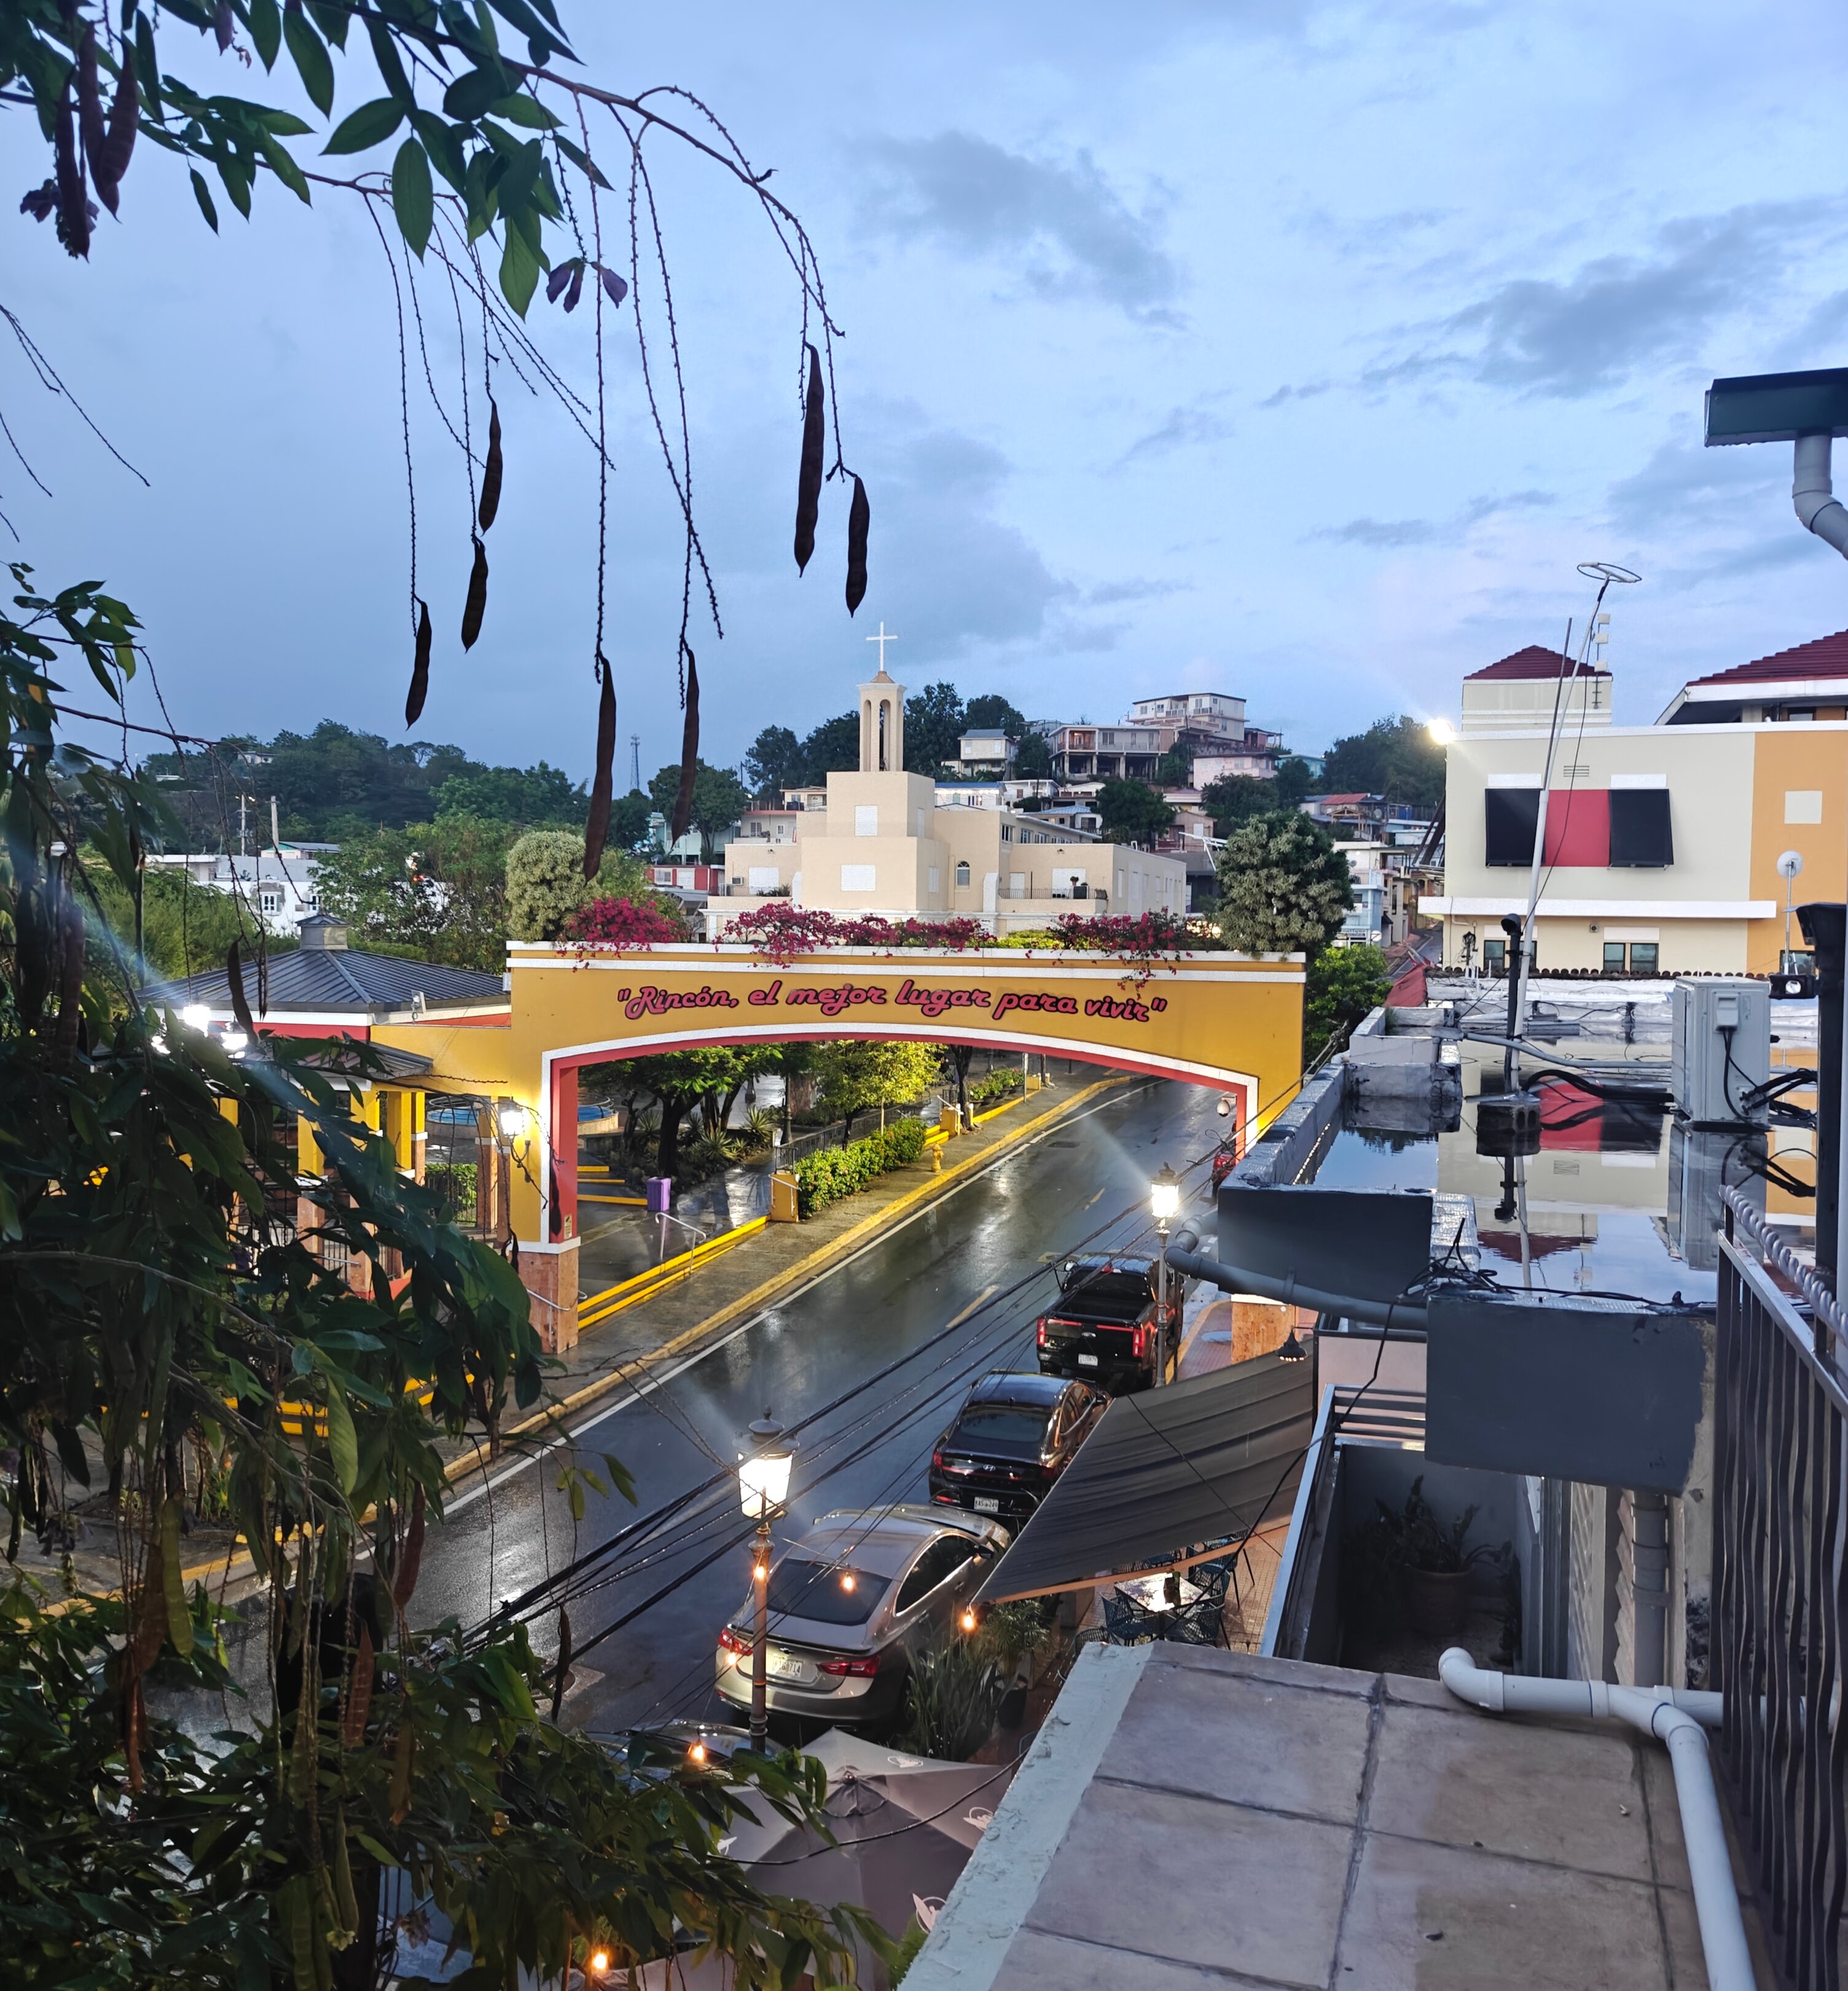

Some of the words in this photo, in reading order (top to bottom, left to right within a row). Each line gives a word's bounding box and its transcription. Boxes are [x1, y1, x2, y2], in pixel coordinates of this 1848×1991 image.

[748, 980, 783, 1005] el
[786, 983, 887, 1016] mejor
[895, 979, 992, 1017] lugar
[992, 993, 1078, 1020] para
[1084, 996, 1168, 1022] vivir"
